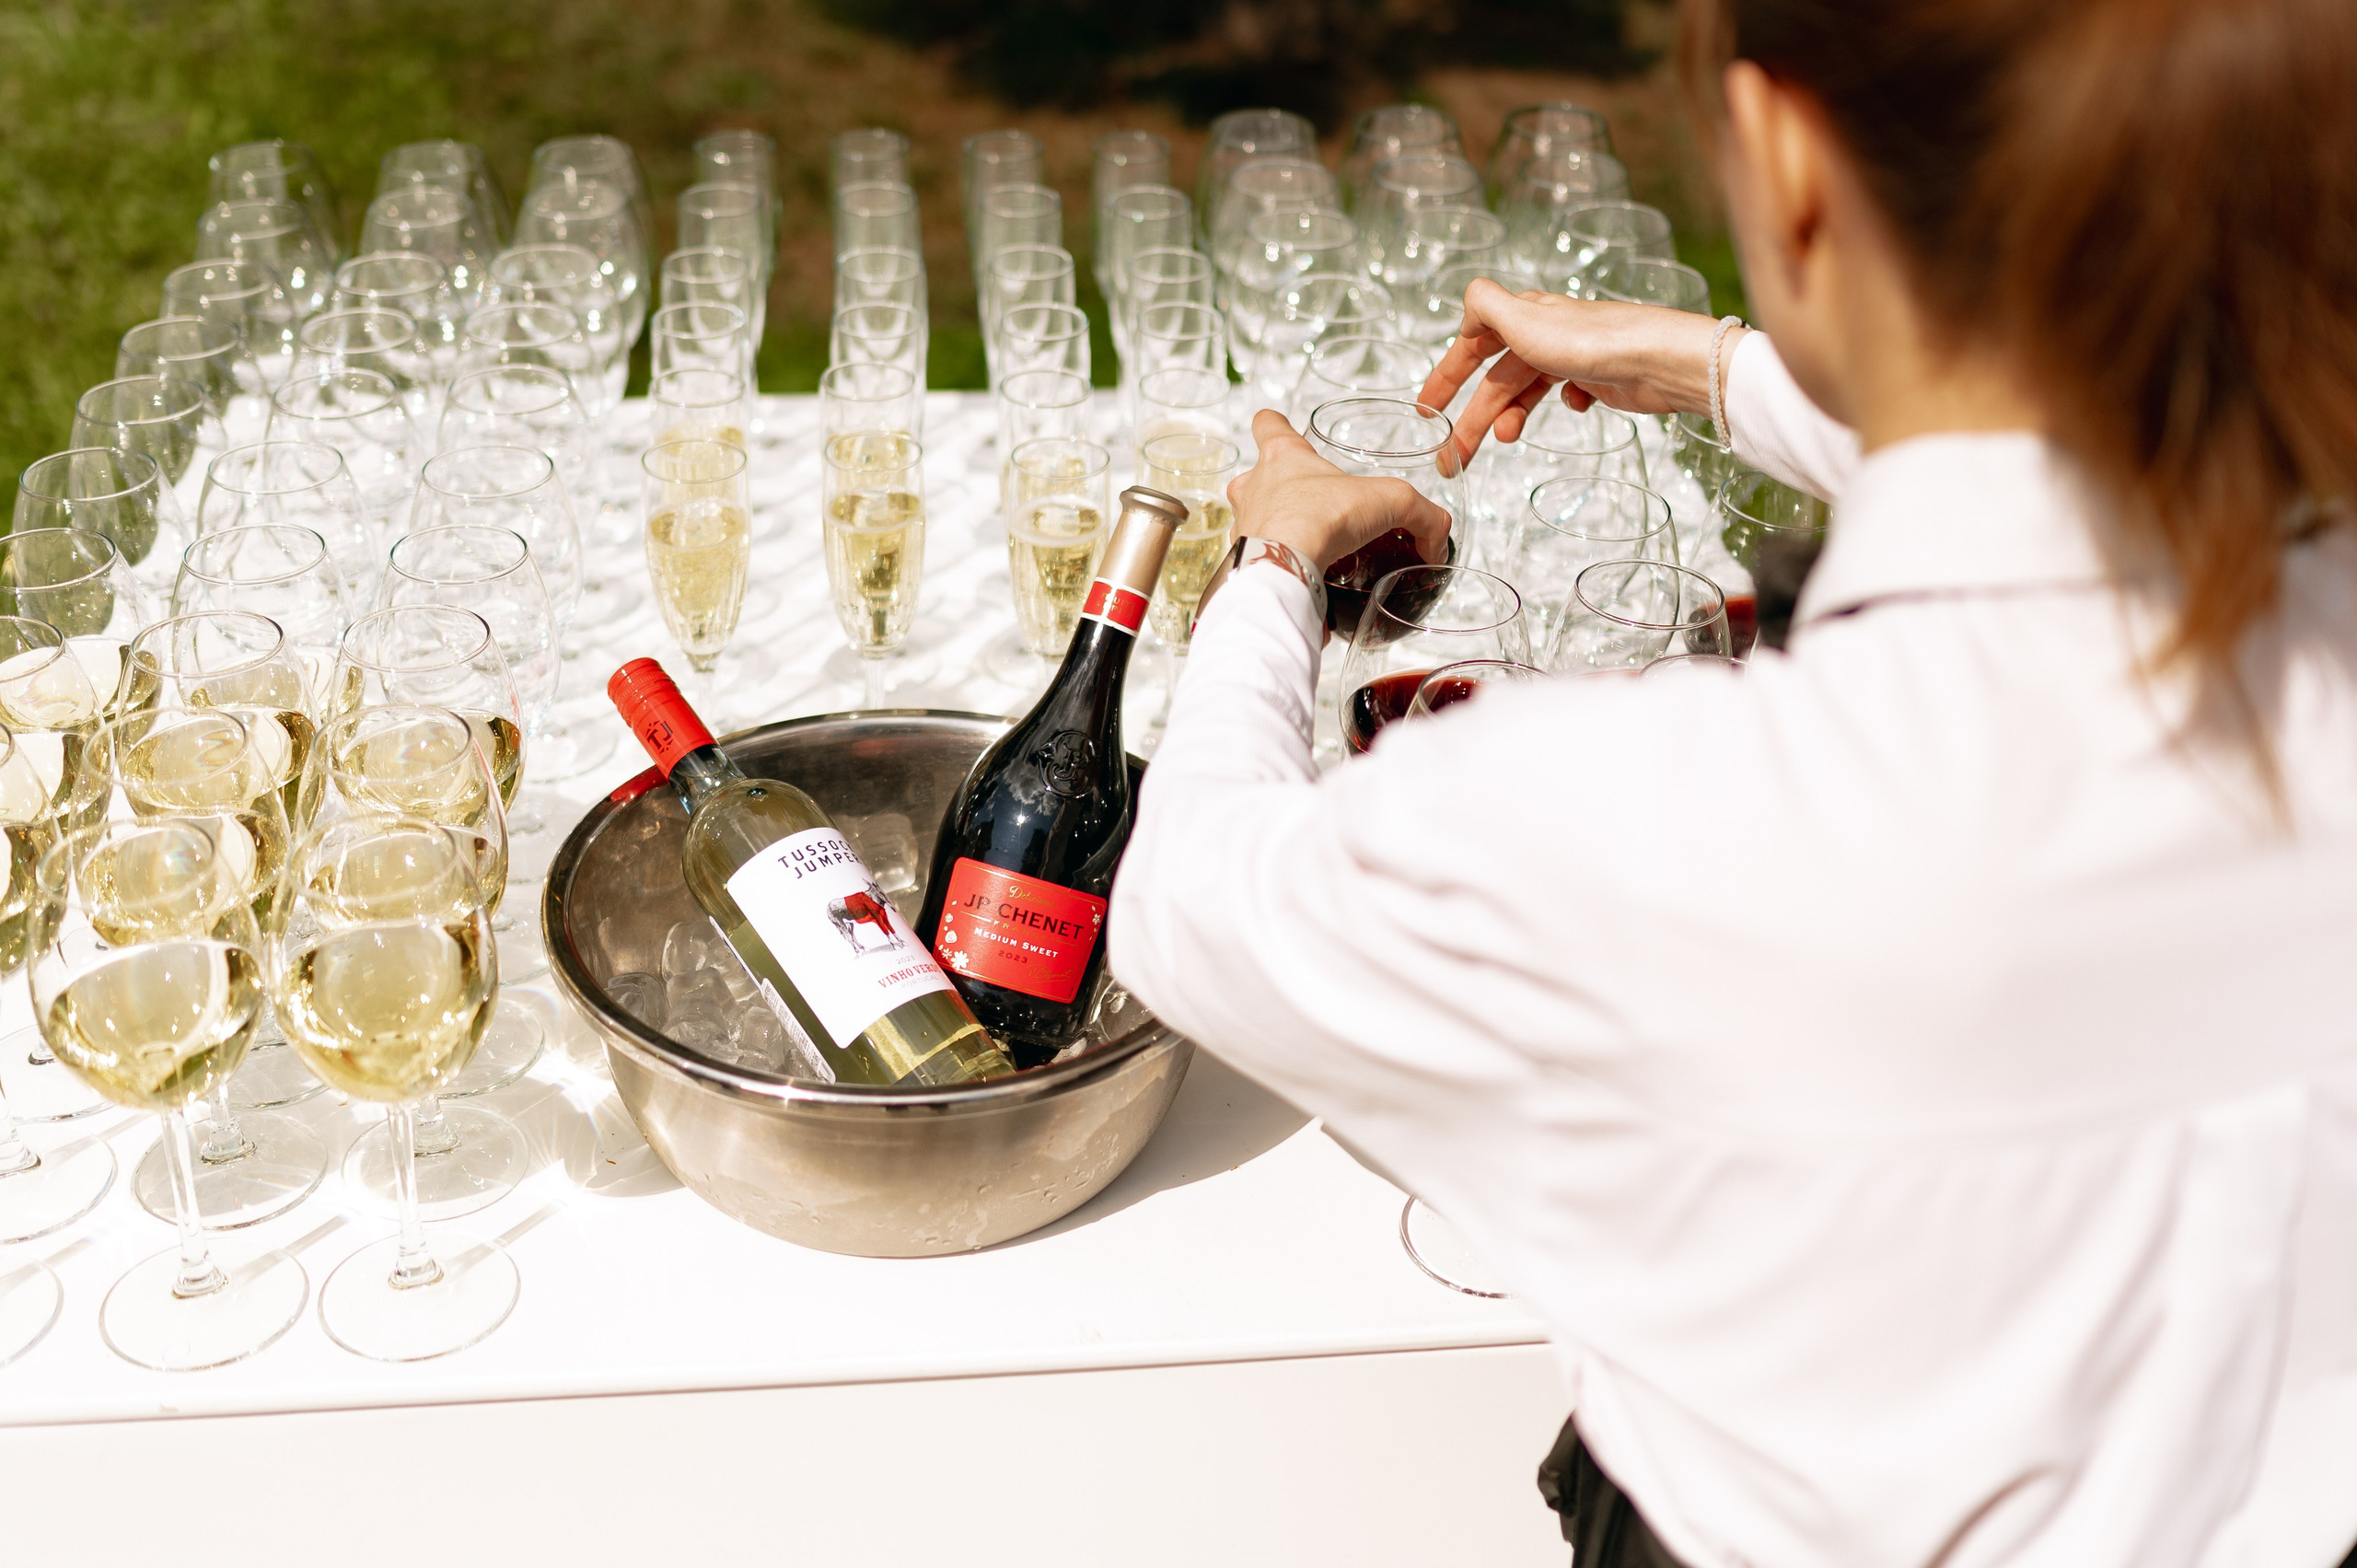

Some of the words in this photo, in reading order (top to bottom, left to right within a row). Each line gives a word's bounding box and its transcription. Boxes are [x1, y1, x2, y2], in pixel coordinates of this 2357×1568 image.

[795, 852, 863, 878] JUMPER
[964, 894, 991, 910] JP
[997, 903, 1085, 939] CHENET
[896, 955, 916, 964] 2023
[998, 950, 1028, 964] 2023
[877, 968, 914, 989] VINHO
[912, 963, 941, 974] VERD
[901, 974, 939, 989] PORTUGAL
